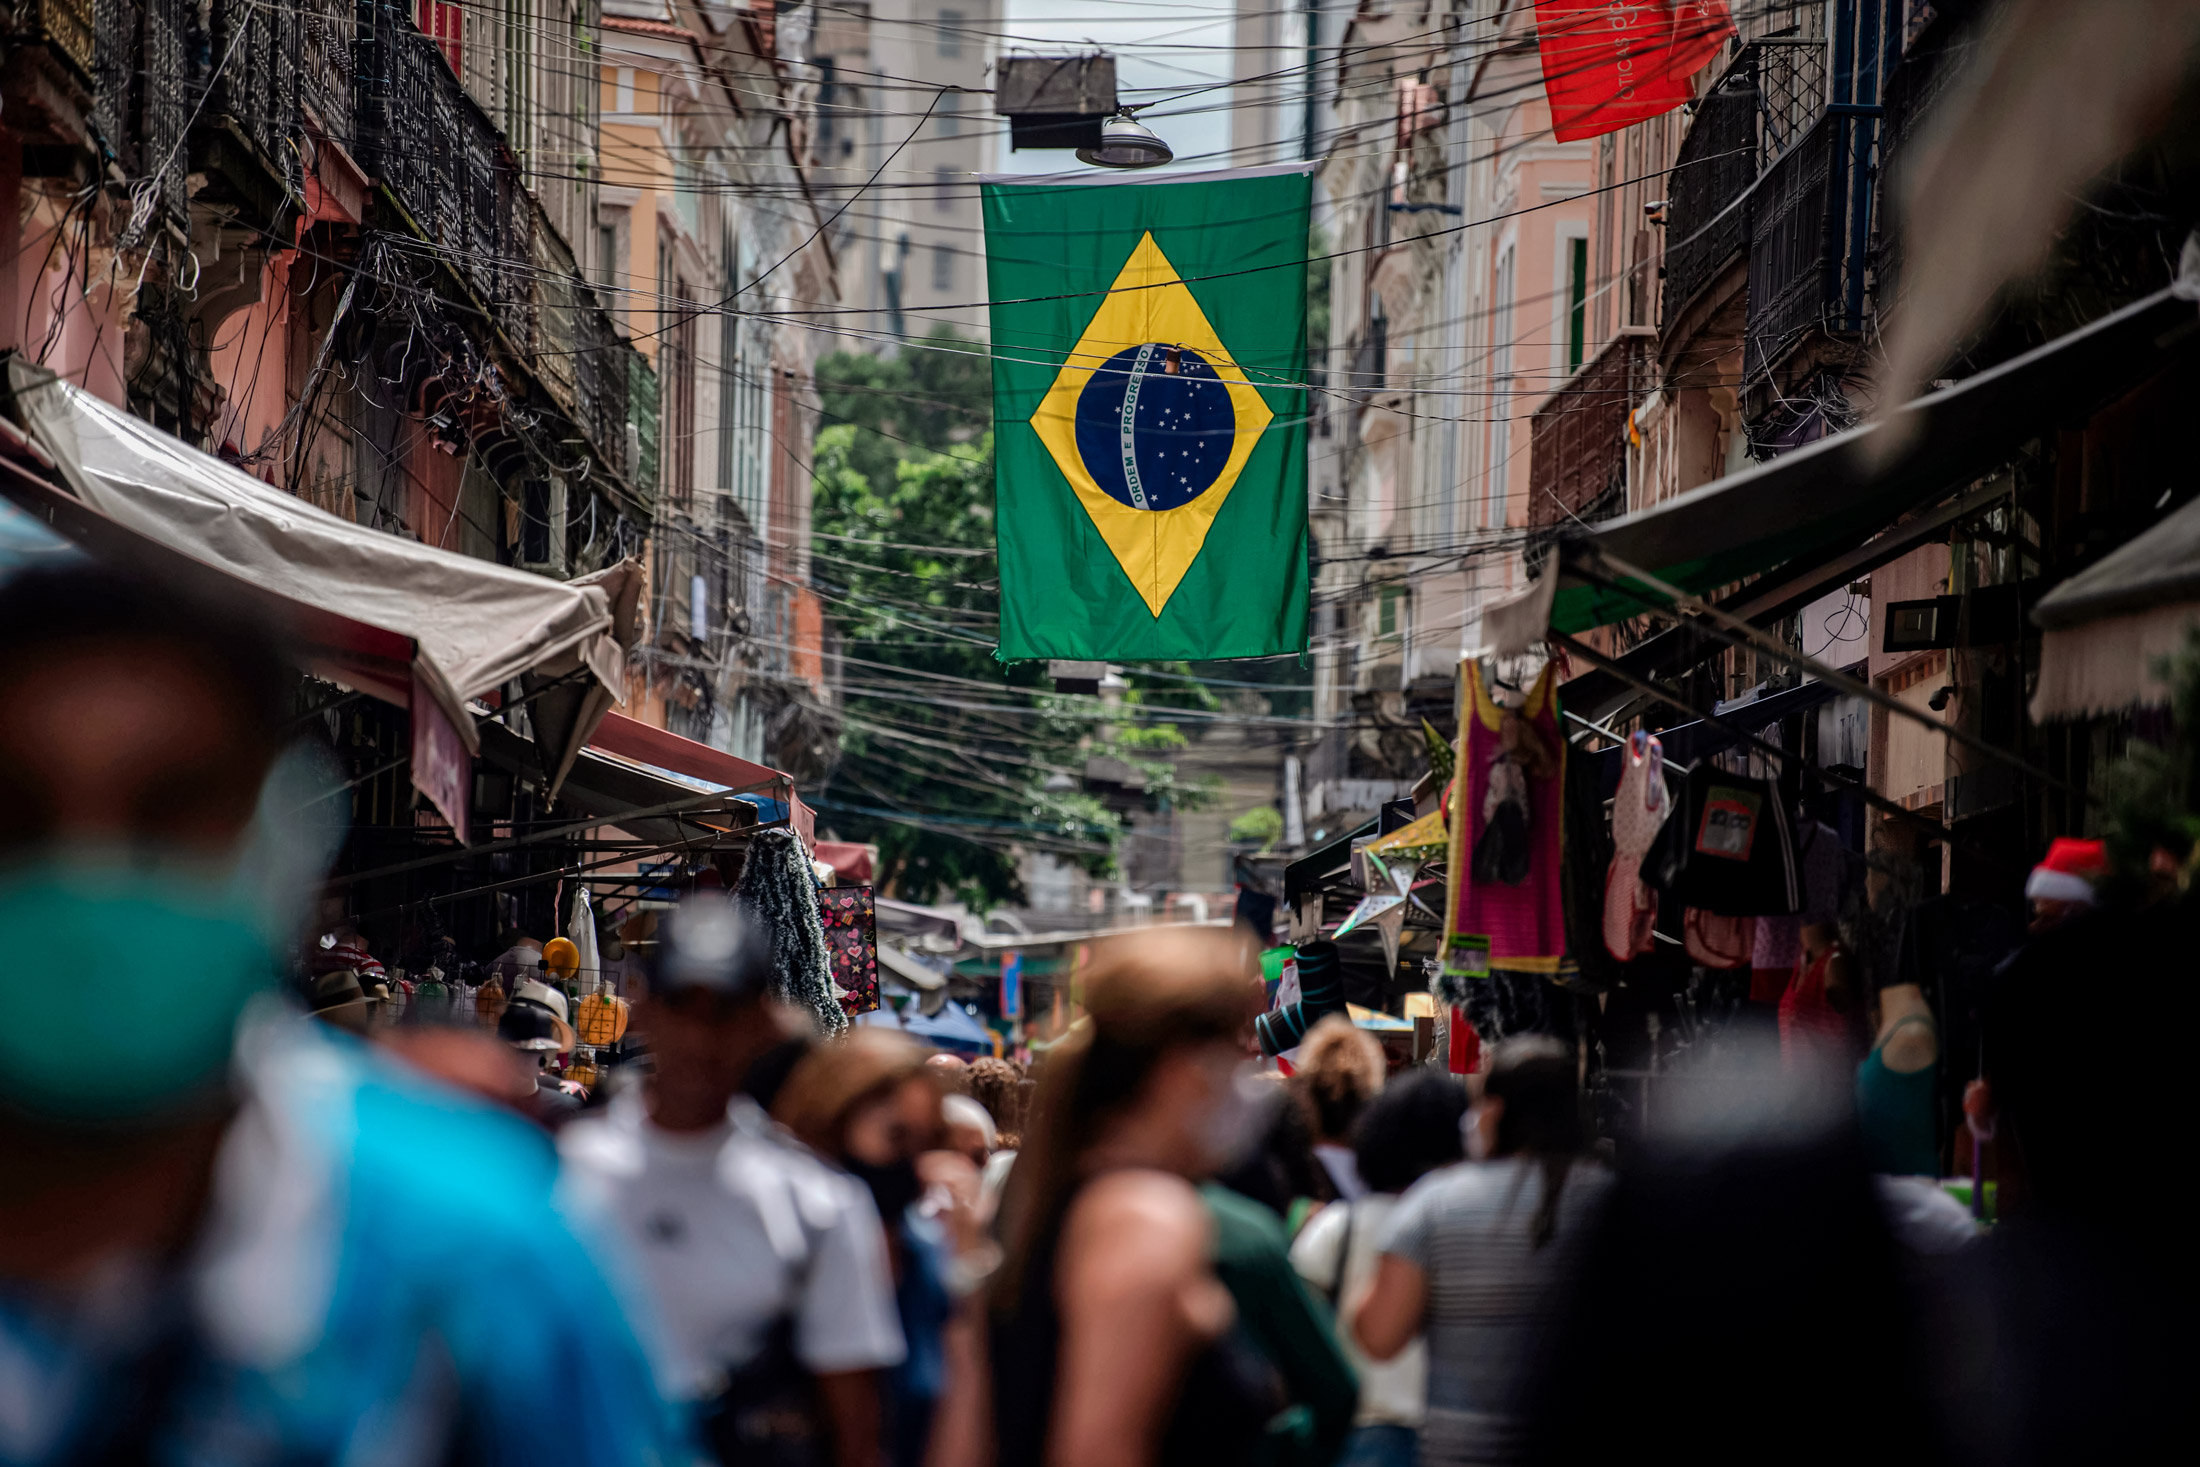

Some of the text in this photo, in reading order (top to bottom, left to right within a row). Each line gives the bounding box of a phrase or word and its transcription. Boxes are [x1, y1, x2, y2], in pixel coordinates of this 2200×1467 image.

[1123, 349, 1149, 503] ORDEM E PROGRESSO
